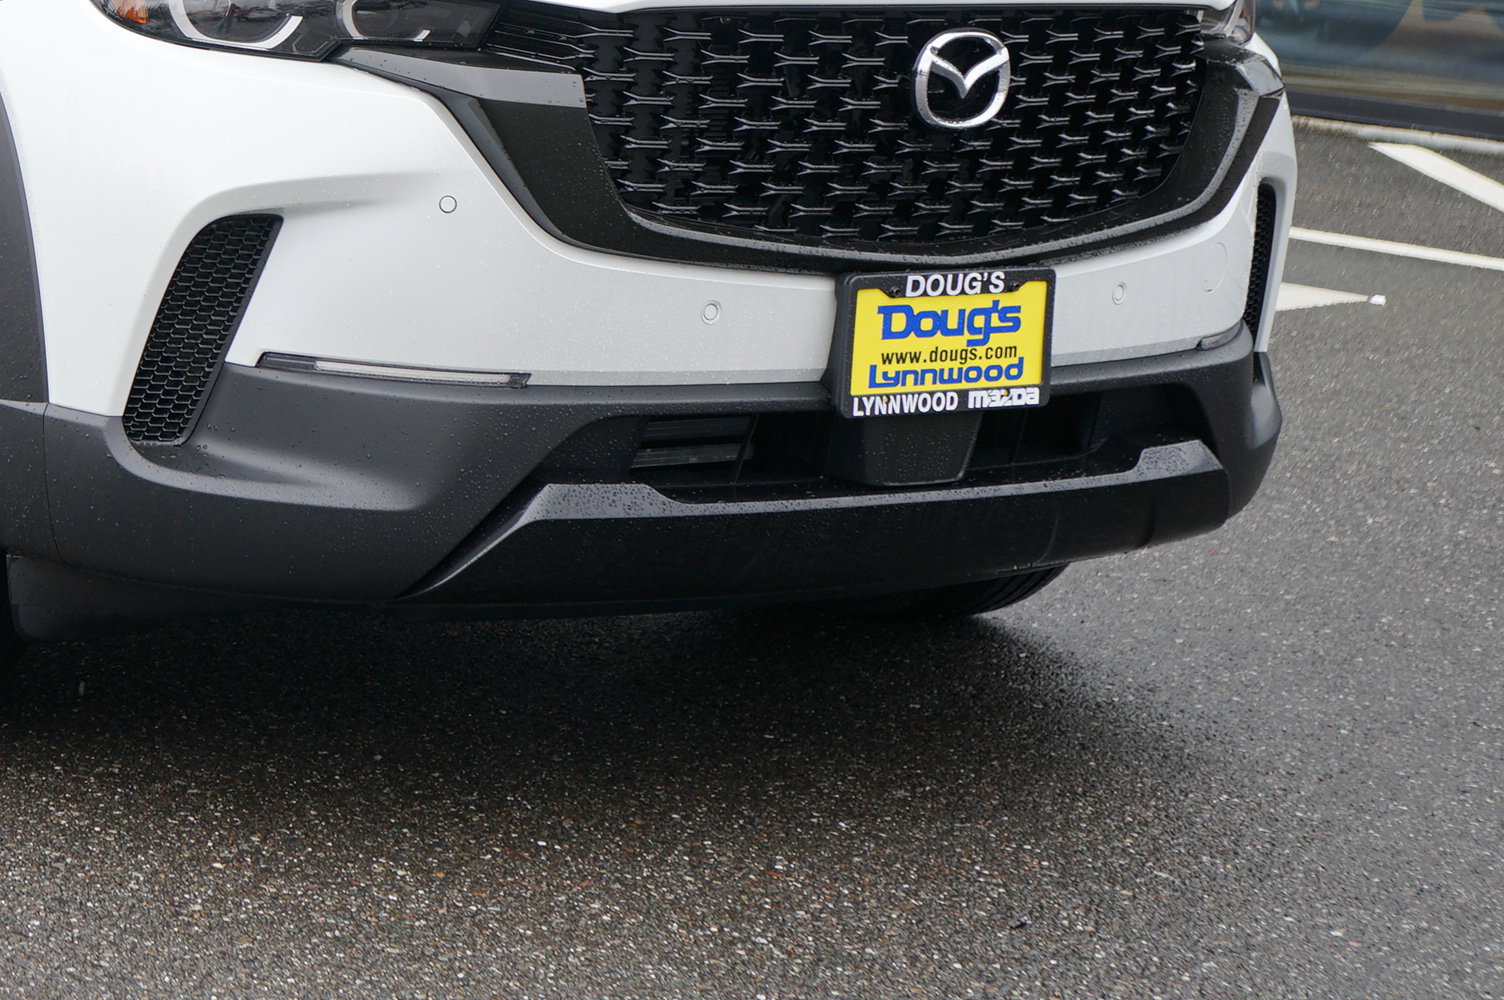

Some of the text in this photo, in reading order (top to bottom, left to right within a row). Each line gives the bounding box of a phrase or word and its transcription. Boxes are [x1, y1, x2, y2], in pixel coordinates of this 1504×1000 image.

[905, 271, 1006, 298] DOUG'S
[881, 345, 1018, 365] www.dougs.com
[868, 356, 1025, 389] Lynnwood
[852, 391, 959, 417] LYNNWOOD
